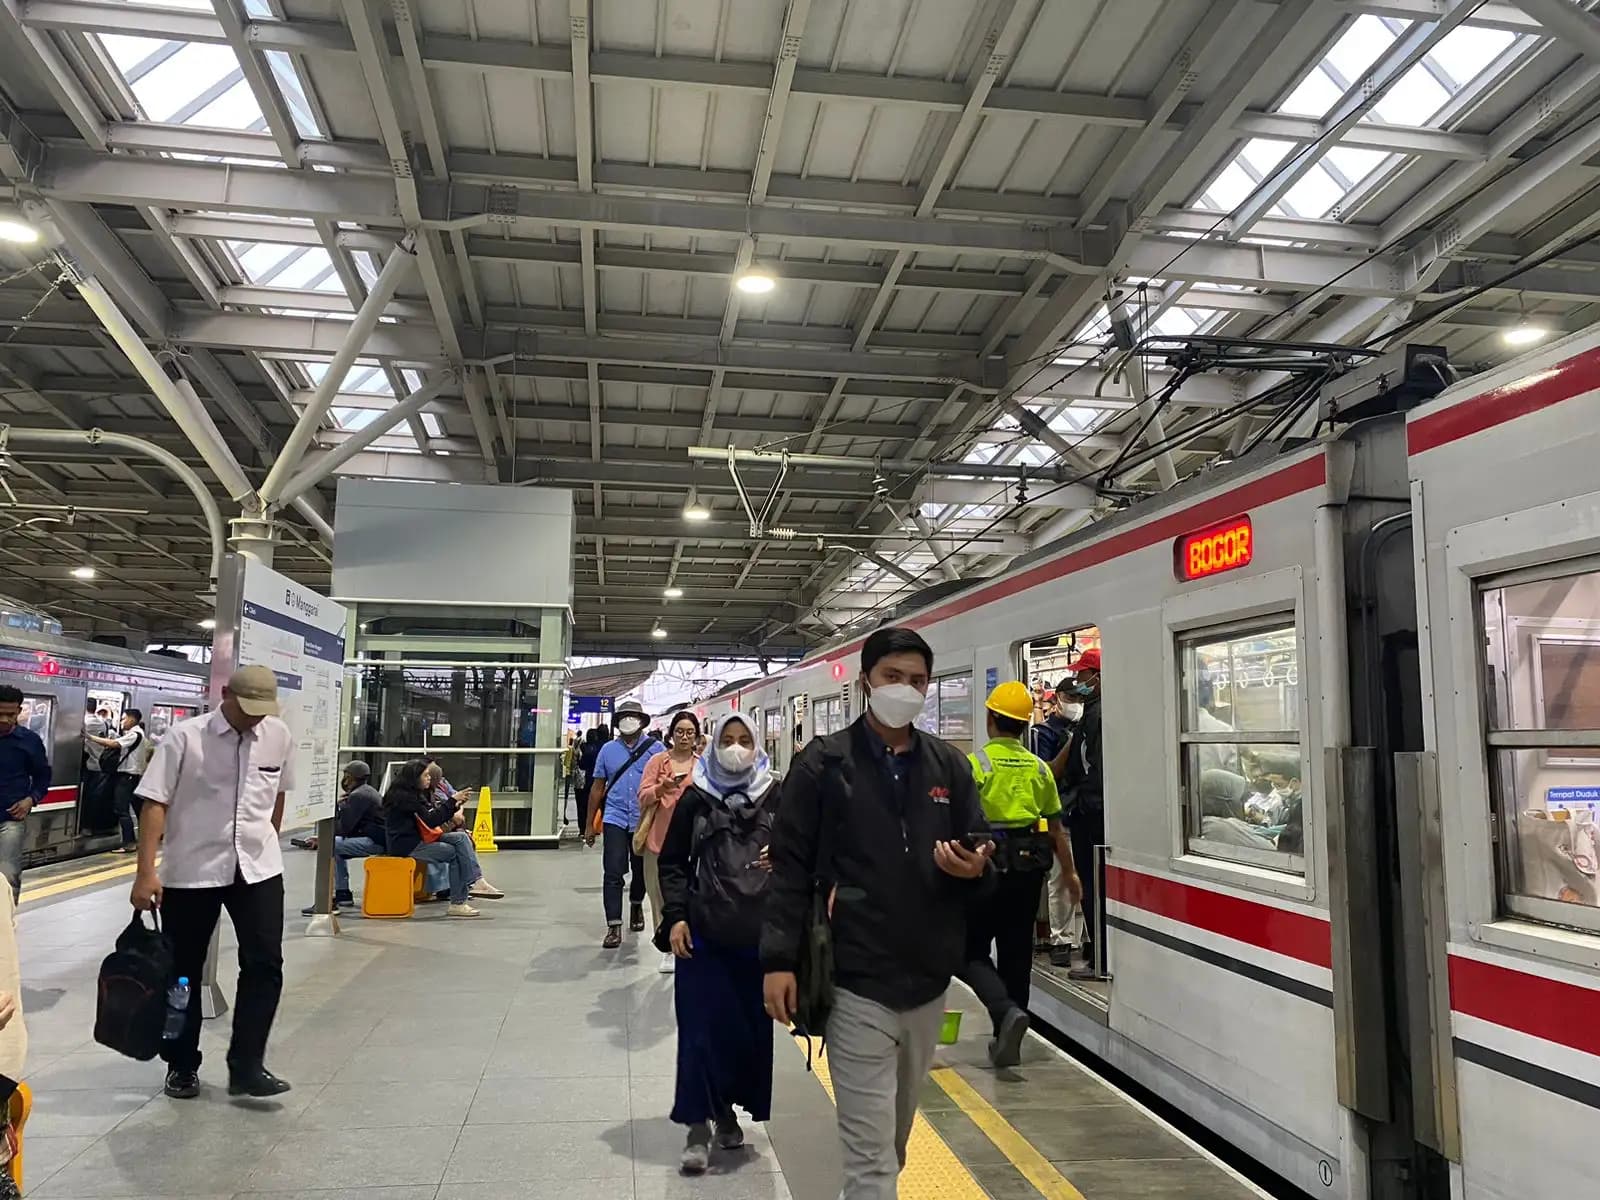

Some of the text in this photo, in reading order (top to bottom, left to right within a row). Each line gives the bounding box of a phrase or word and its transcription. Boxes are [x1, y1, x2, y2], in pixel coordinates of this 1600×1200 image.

[1190, 526, 1250, 575] BOGOR
[600, 698, 609, 706] 12
[1576, 790, 1598, 798] Duduk
